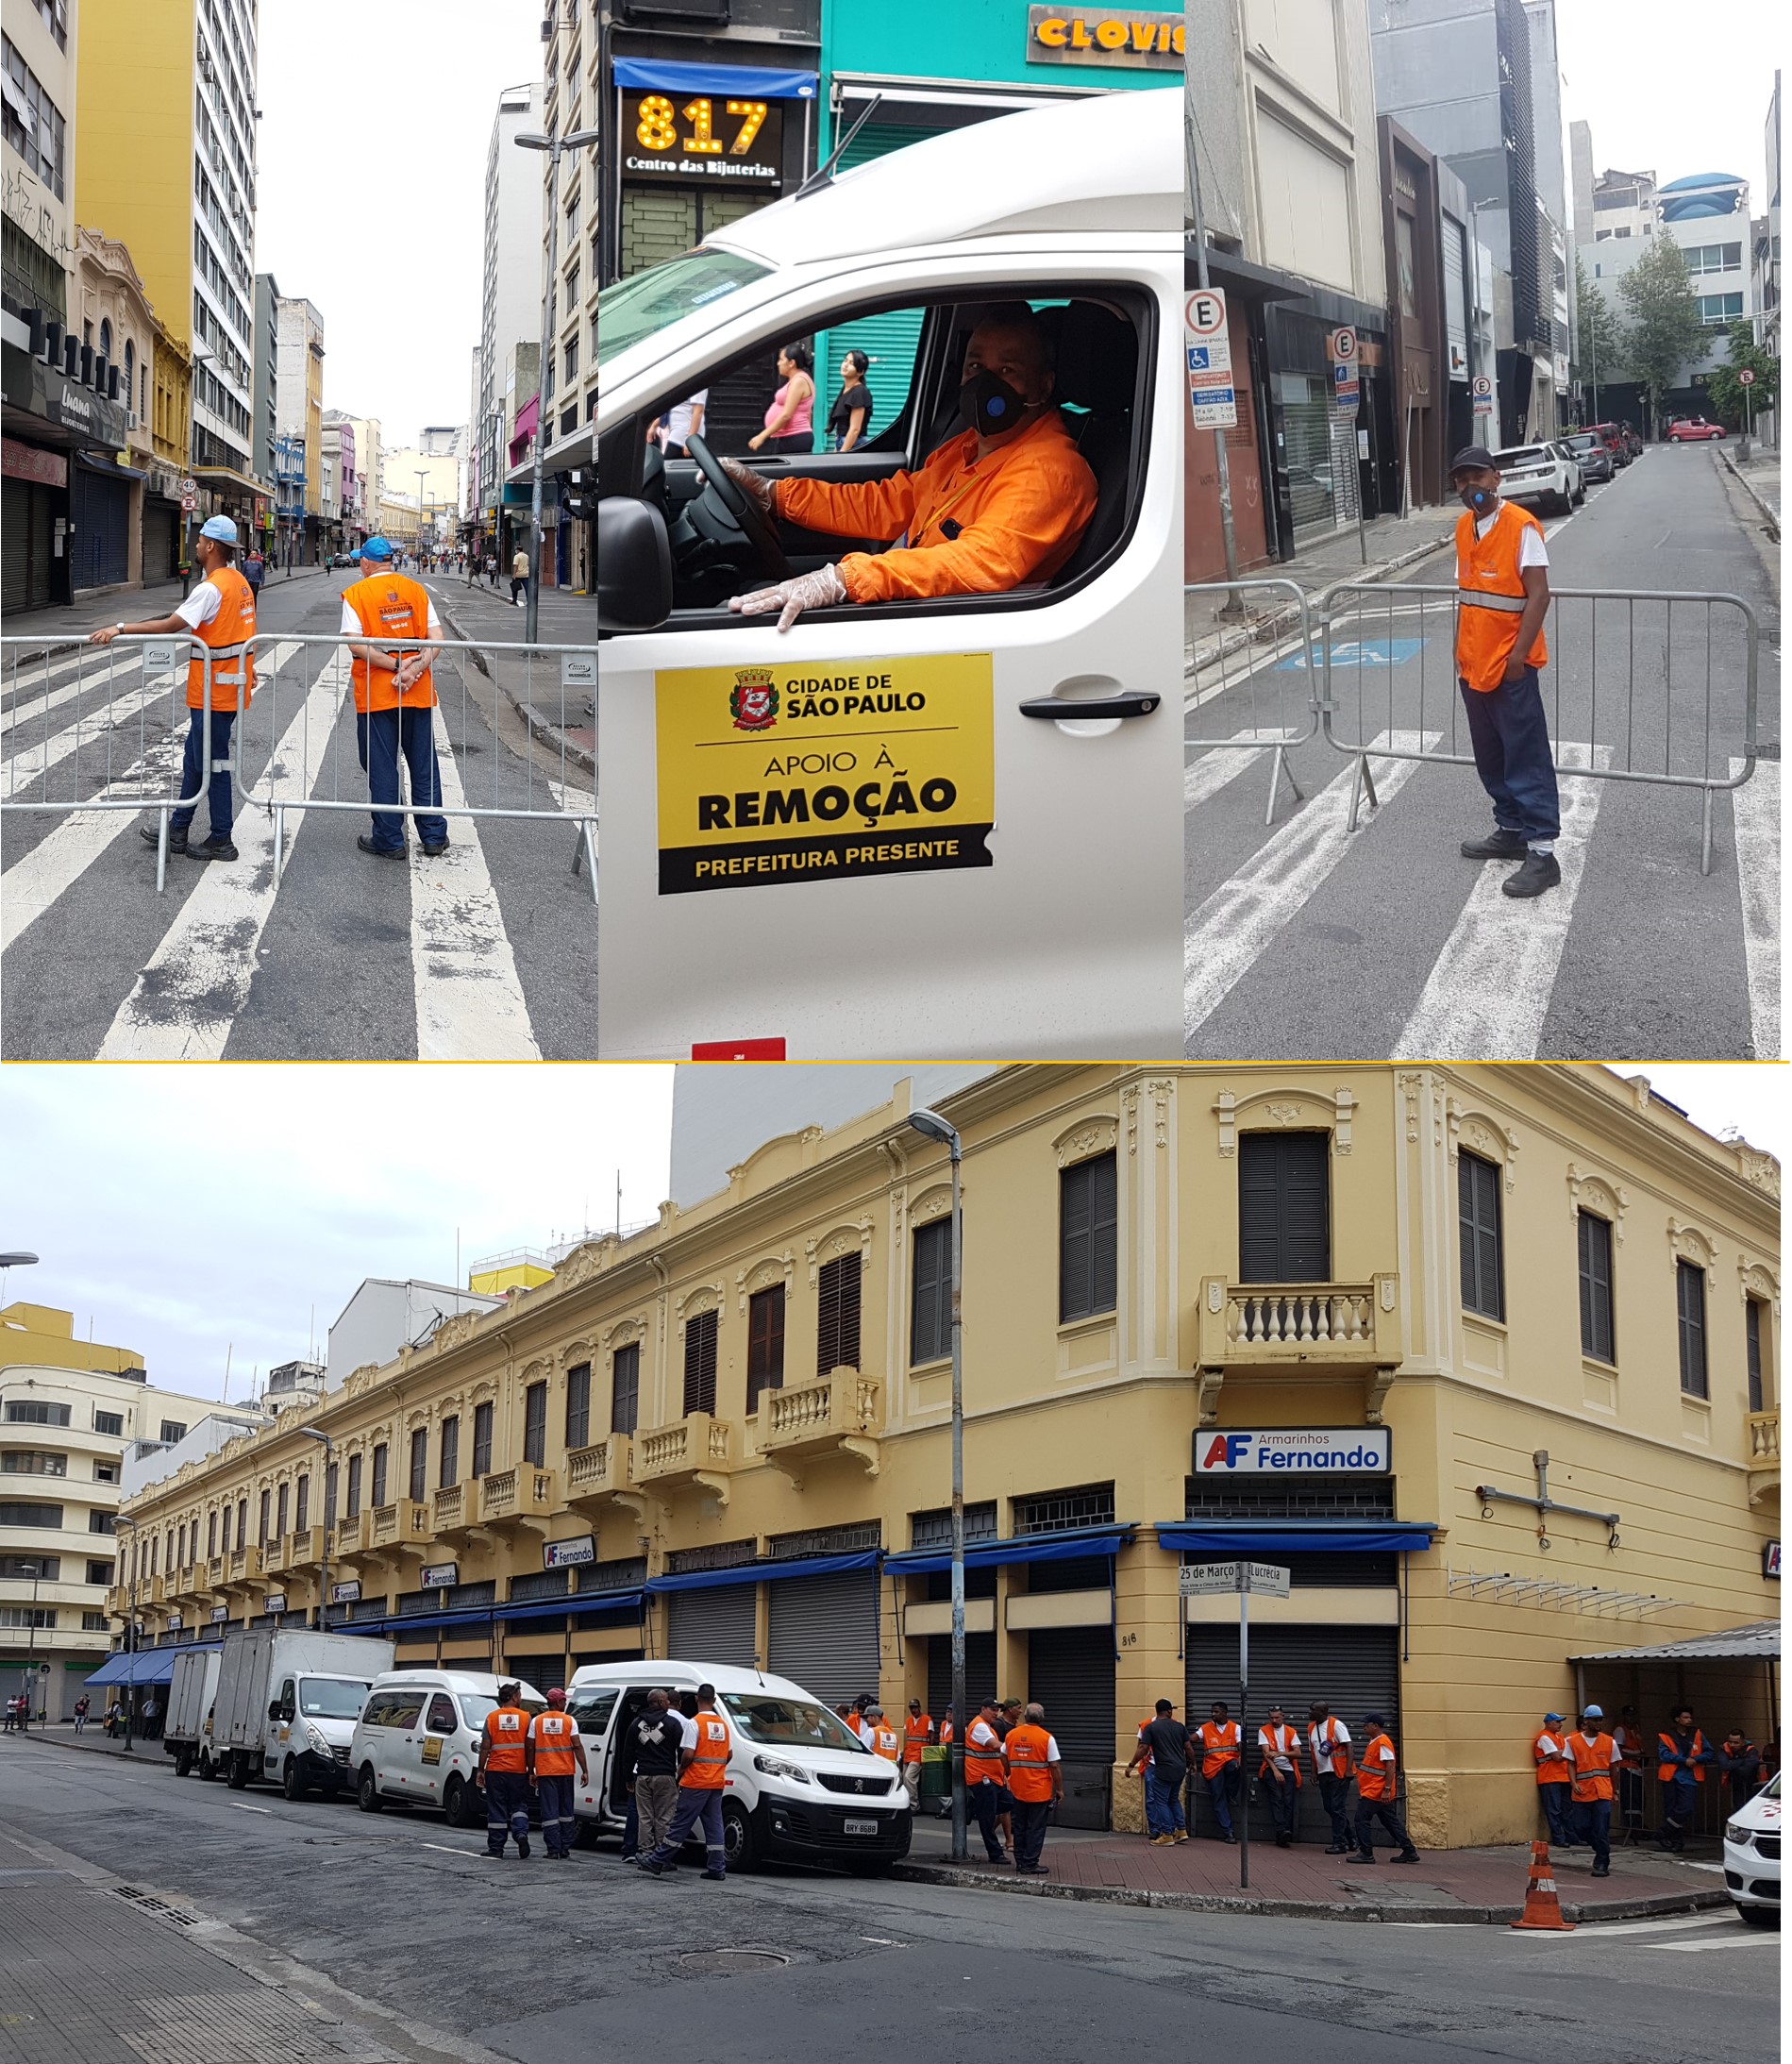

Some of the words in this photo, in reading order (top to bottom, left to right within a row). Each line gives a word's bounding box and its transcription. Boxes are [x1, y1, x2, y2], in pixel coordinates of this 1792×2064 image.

[636, 95, 767, 155] 817
[626, 156, 677, 171] Centro
[678, 159, 704, 172] das
[706, 160, 776, 176] Bijuterias
[1197, 300, 1213, 326] E
[1340, 335, 1349, 353] E
[1479, 380, 1485, 392] E
[61, 384, 90, 418] Luana
[183, 480, 194, 489] 40
[786, 676, 861, 695] CIDADE
[866, 674, 893, 690] DE
[786, 694, 839, 719] SÃO
[843, 691, 927, 716] PAULO
[763, 751, 857, 778] APOIO
[873, 743, 896, 769] À
[697, 769, 958, 831] REMOÇÃO
[695, 849, 839, 878] PREFEITURA
[845, 839, 960, 864] PRESENTE
[1203, 1435, 1253, 1468] AF
[1258, 1433, 1330, 1445] Armarinhos
[1258, 1445, 1380, 1468] Fernando
[559, 1546, 593, 1564] Fernando
[431, 1571, 456, 1586] Fernando
[1180, 1568, 1191, 1580] 25
[1193, 1567, 1205, 1579] de
[1207, 1565, 1234, 1579] Março
[1250, 1565, 1281, 1580] Lucrécia
